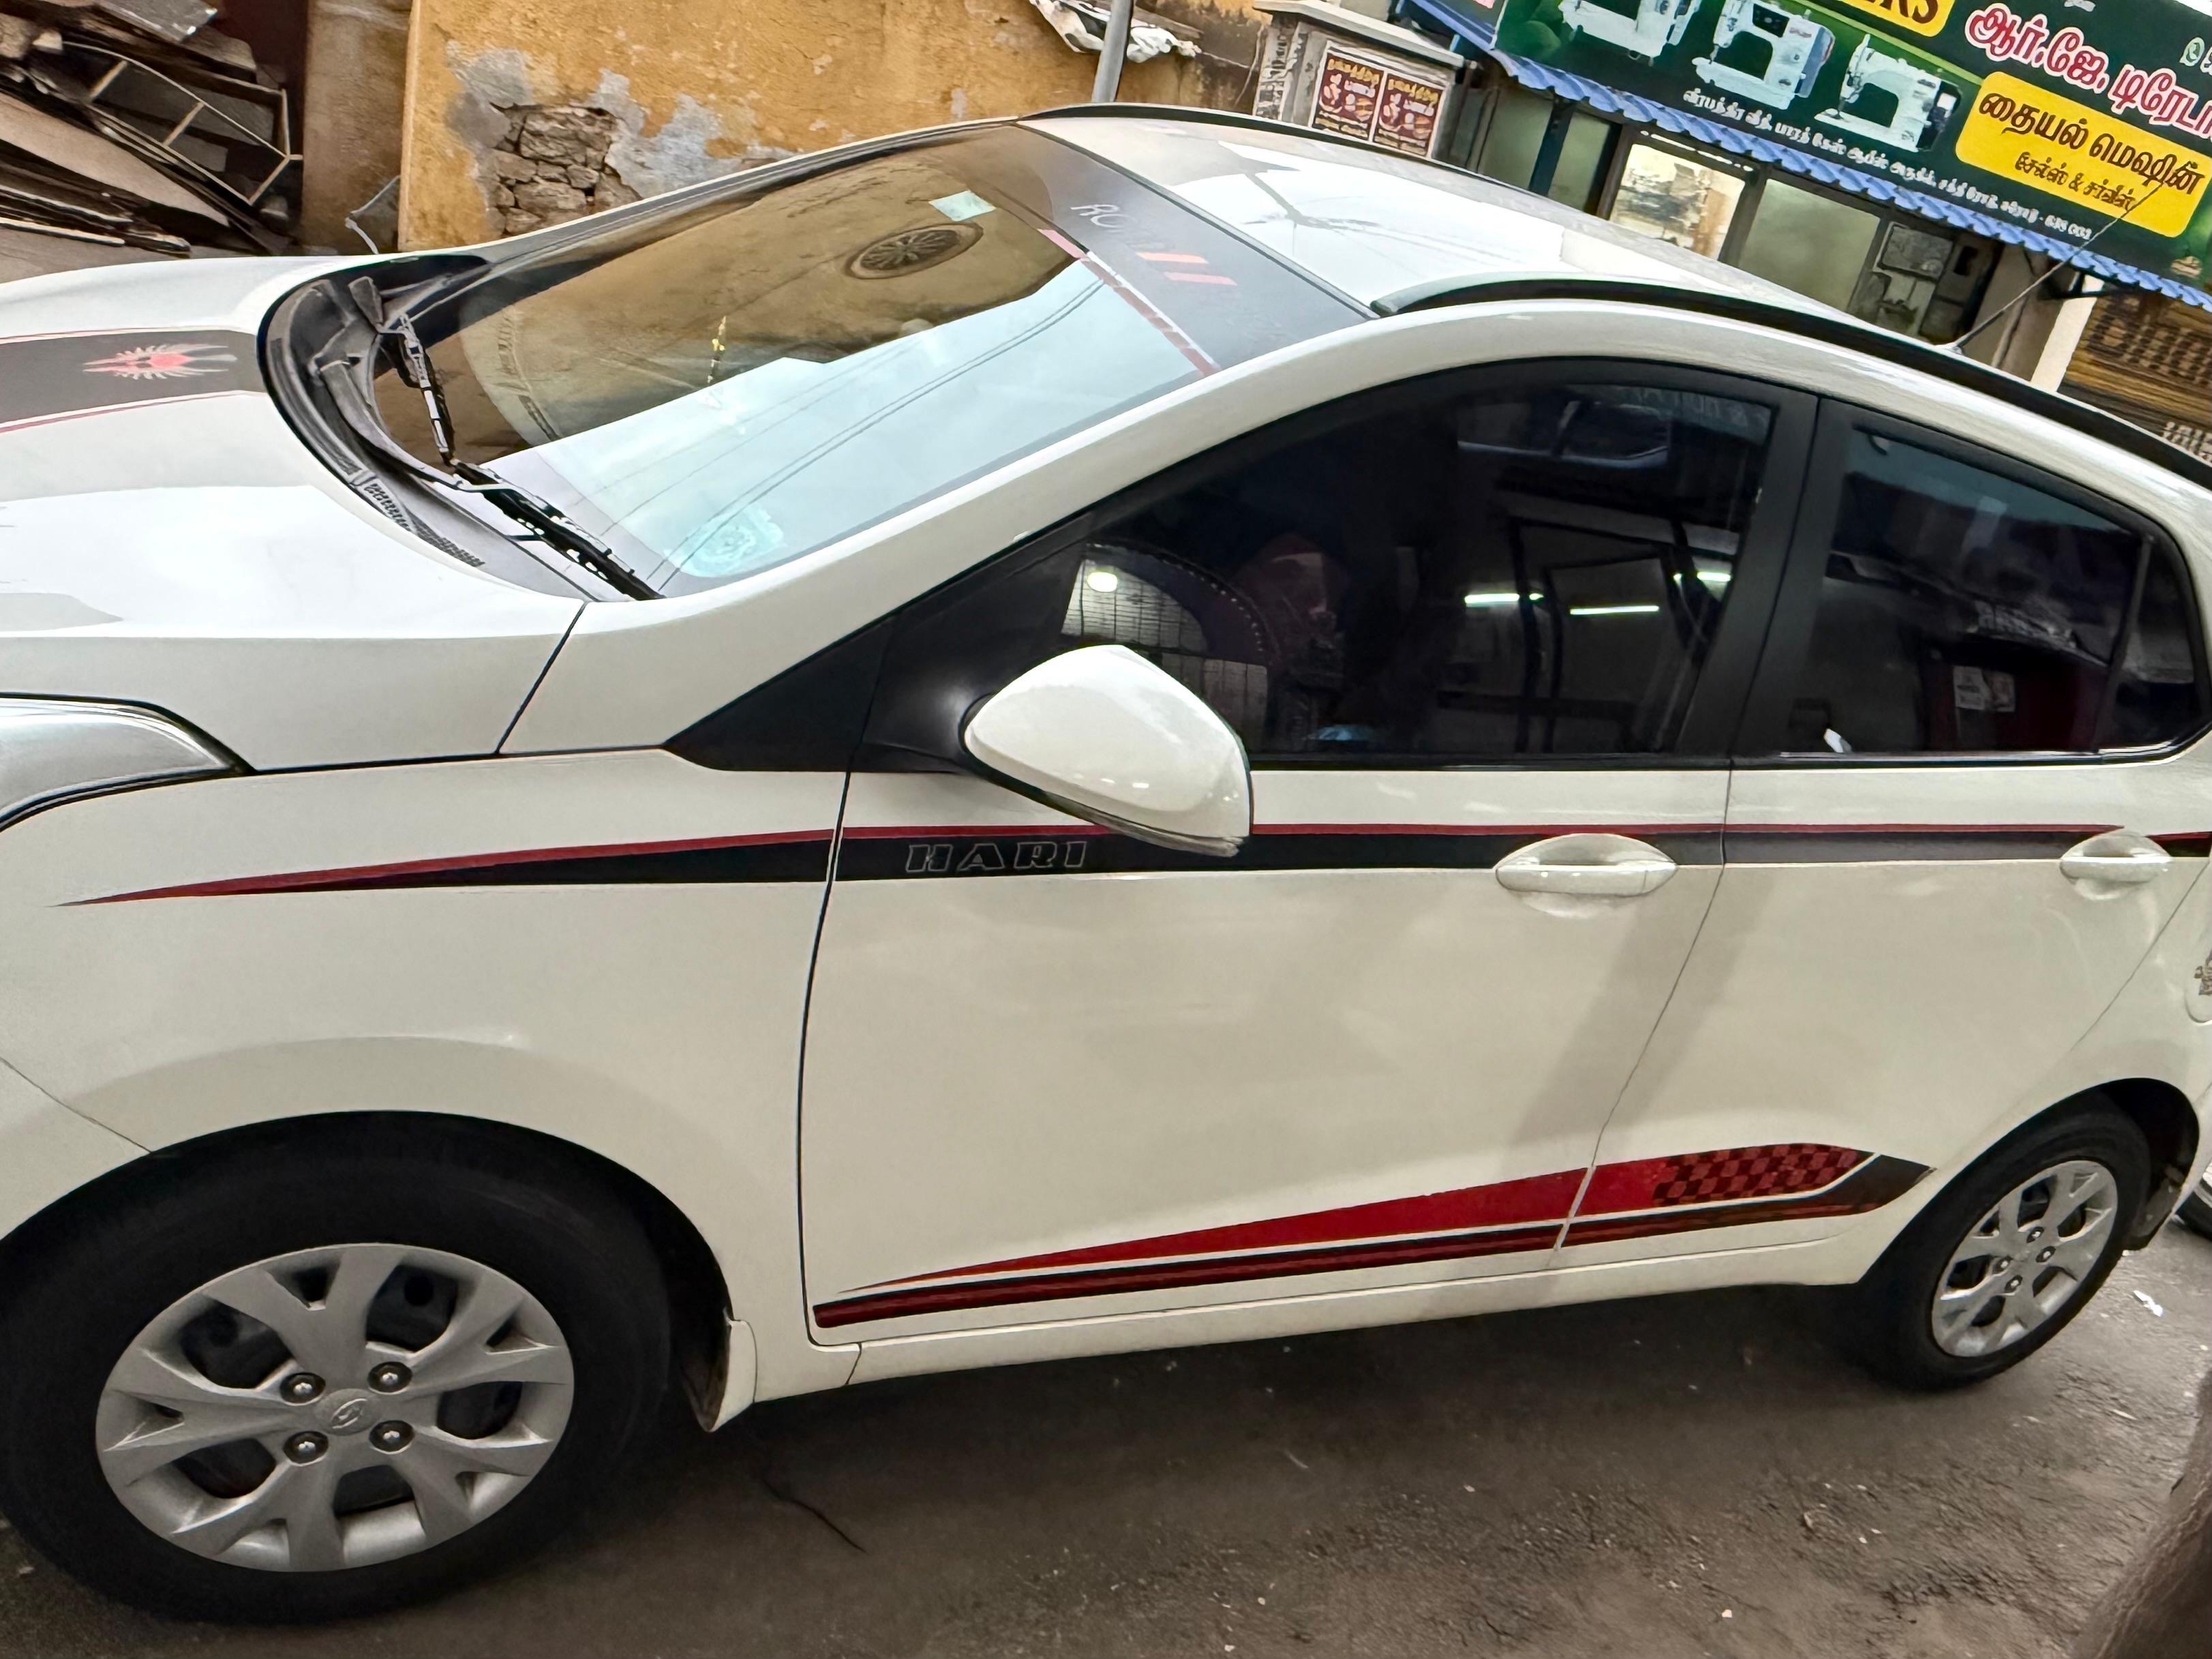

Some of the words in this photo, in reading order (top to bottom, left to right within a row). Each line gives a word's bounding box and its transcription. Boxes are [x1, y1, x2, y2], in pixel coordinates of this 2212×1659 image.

[1979, 93, 2089, 149] தையல்
[2089, 133, 2205, 195] மெஷின்
[2015, 151, 2068, 186] சேல்ஸ்
[2068, 173, 2084, 192] &
[905, 841, 1087, 873] HARI
